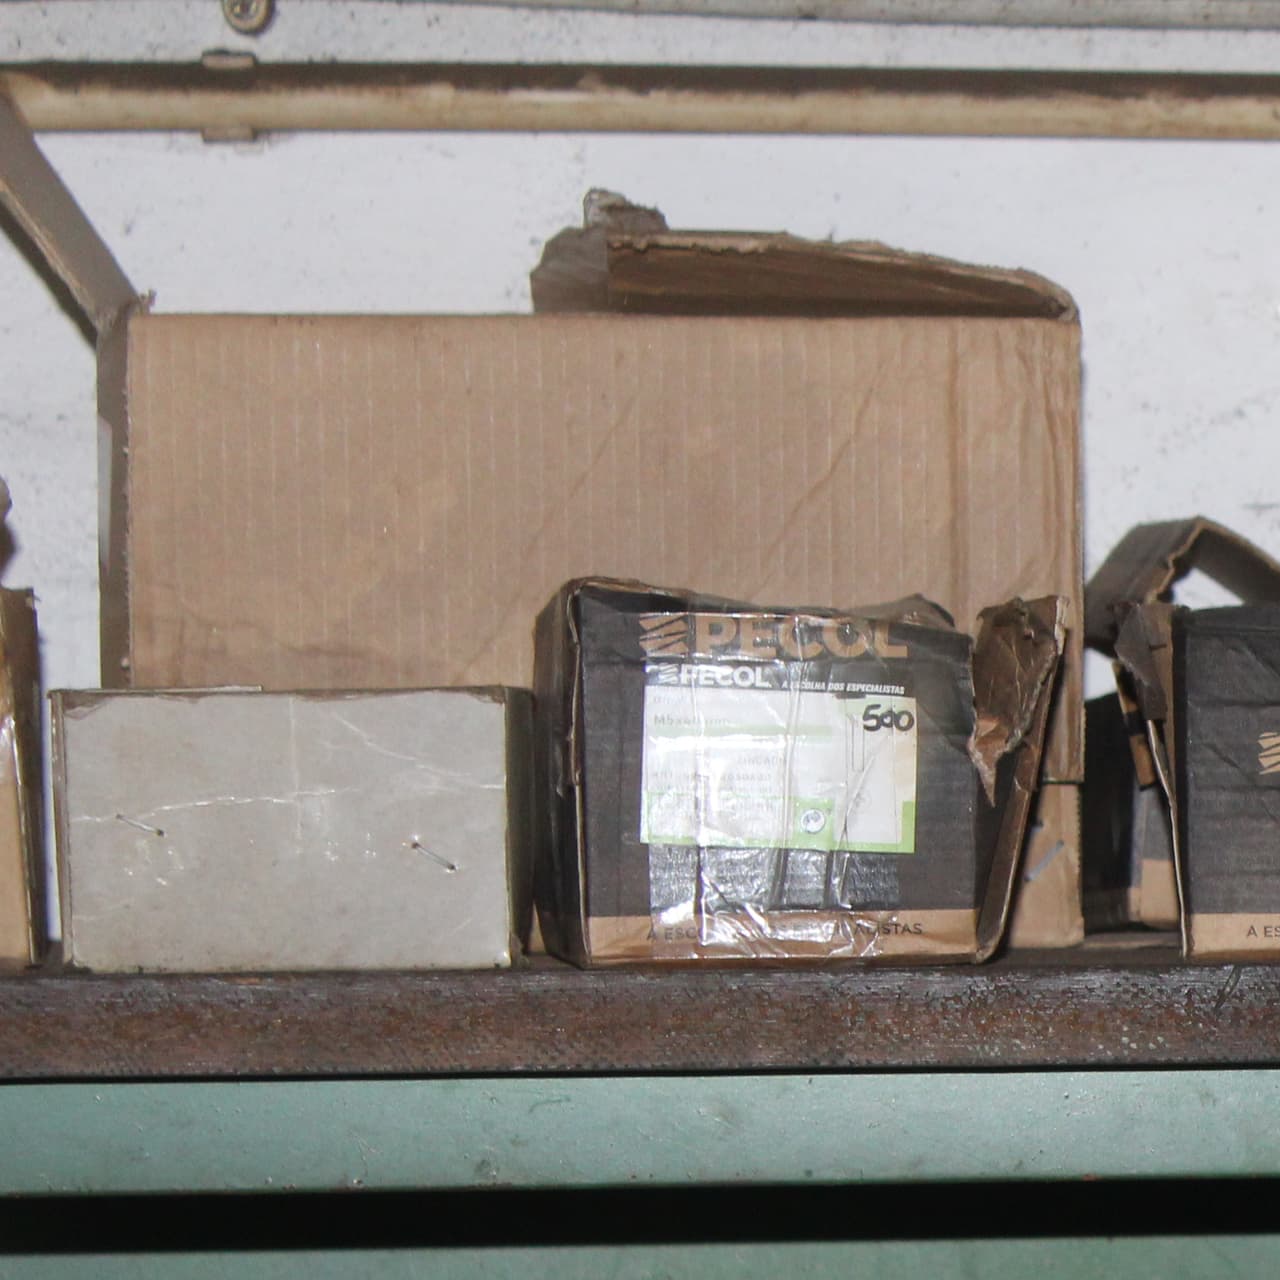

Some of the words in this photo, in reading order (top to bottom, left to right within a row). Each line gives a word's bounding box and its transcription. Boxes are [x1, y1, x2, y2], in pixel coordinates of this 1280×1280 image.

[697, 613, 908, 658] PECOL
[827, 681, 845, 691] DOS
[846, 682, 905, 695] ESPECIALISTAS
[862, 703, 915, 732] 500
[1246, 924, 1258, 937] A
